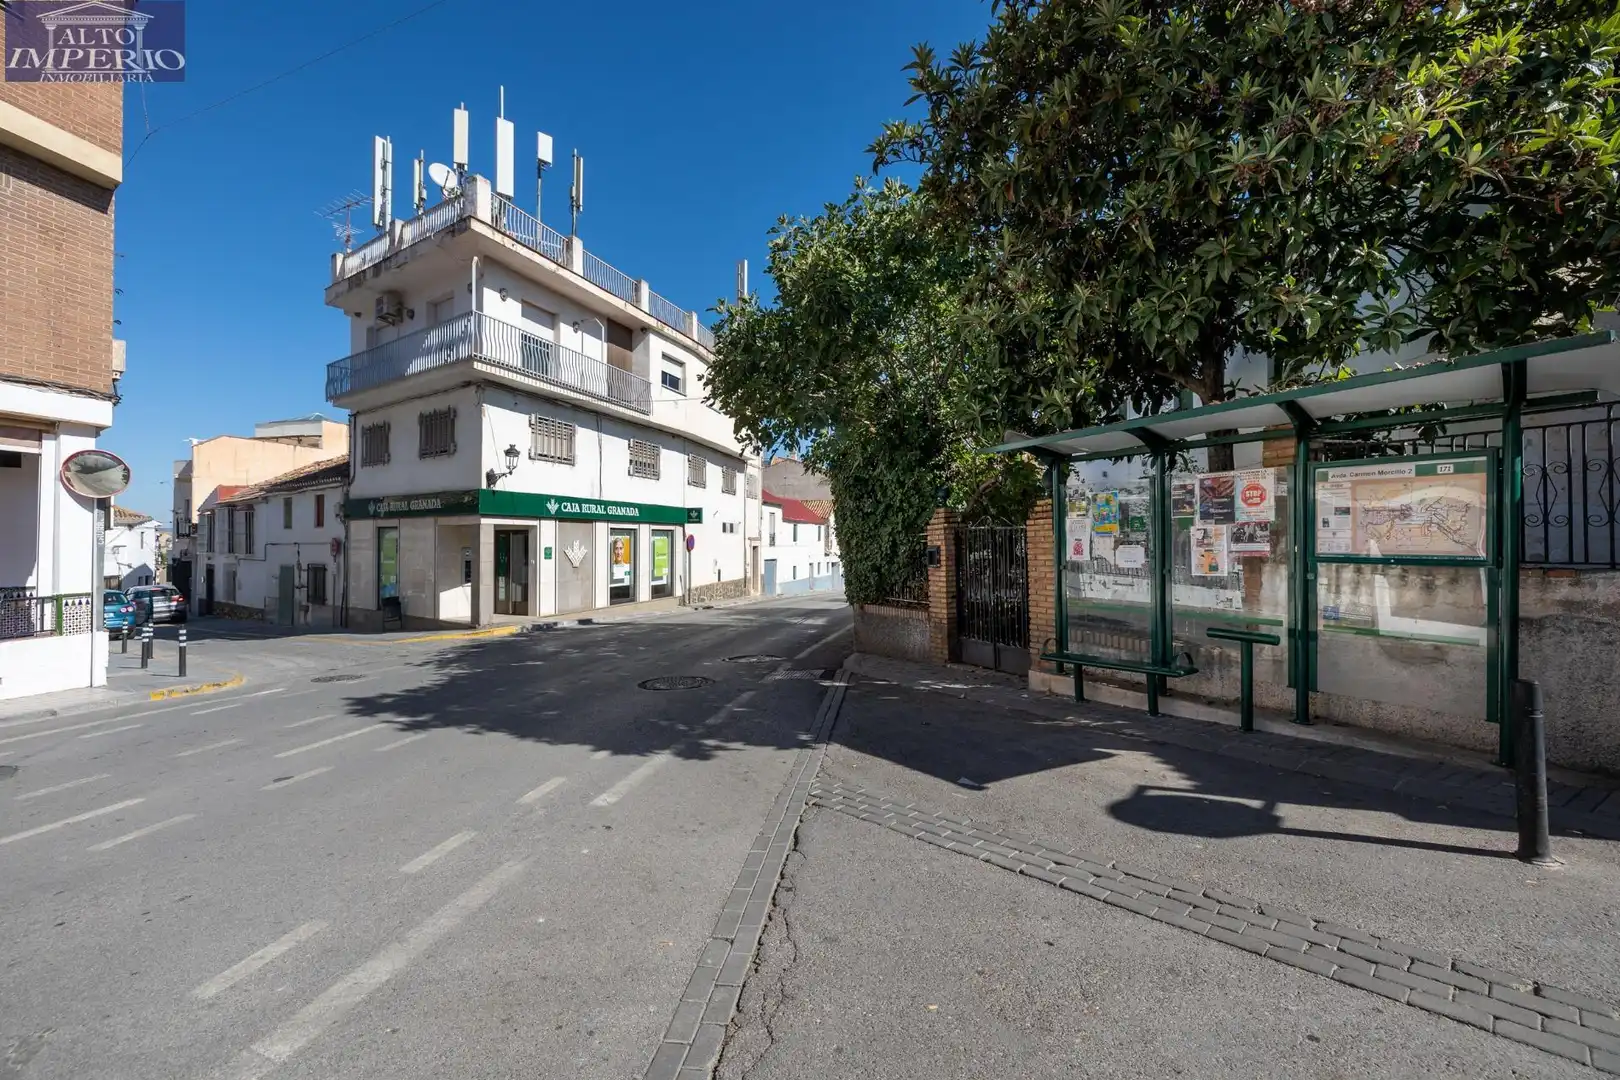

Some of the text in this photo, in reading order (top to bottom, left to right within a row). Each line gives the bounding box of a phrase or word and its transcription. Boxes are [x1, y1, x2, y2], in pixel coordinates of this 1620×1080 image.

[1377, 468, 1406, 476] Morcillo
[376, 498, 442, 513] CAJA RURAL GRANADA
[561, 502, 640, 516] CAJA RURAL GRANADA
